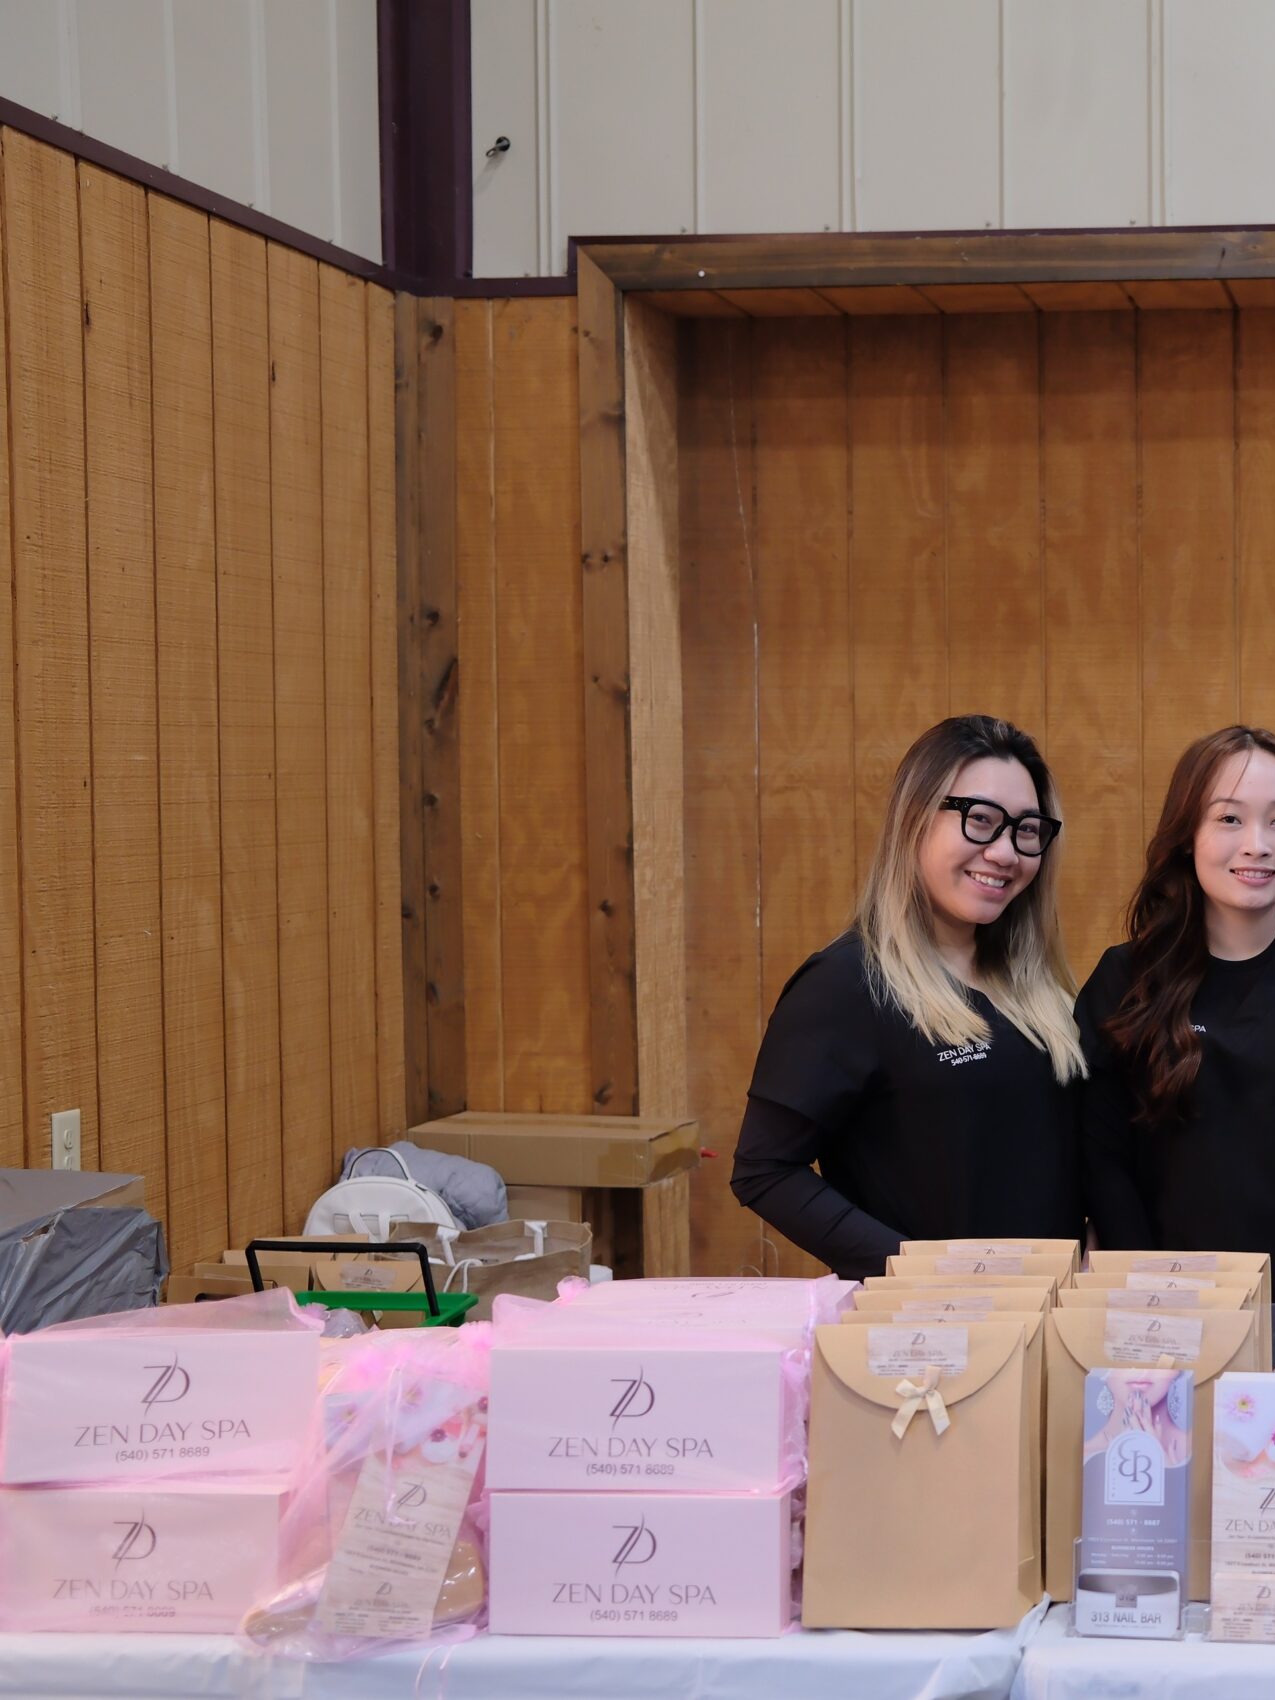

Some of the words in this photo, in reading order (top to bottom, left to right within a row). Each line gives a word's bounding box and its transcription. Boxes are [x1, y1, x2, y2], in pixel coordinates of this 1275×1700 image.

[937, 1049, 958, 1062] ZEN
[957, 1044, 974, 1056] DAY
[74, 1425, 129, 1447] ZEN
[139, 1421, 193, 1444] DAY
[201, 1418, 252, 1441] SPA
[115, 1449, 149, 1463] (540)
[153, 1448, 174, 1460] 571
[178, 1446, 210, 1458] 8689
[548, 1436, 599, 1458] ZEN
[608, 1437, 658, 1458] DAY
[665, 1437, 714, 1459] SPA
[586, 1463, 617, 1476] (540)
[620, 1463, 641, 1475] 571
[354, 1507, 385, 1525] ZEN
[424, 1521, 451, 1539] SPA
[1225, 1519, 1254, 1532] ZEN
[52, 1578, 102, 1600] ZEN
[110, 1579, 159, 1601] DAY
[167, 1580, 215, 1601] SPA
[552, 1582, 602, 1604] ZEN
[611, 1583, 661, 1604] DAY
[668, 1583, 717, 1606] SPA
[590, 1609, 622, 1623] (540)
[623, 1609, 645, 1621] 571
[648, 1610, 679, 1622] 8689
[1090, 1611, 1110, 1623] 313
[1113, 1611, 1137, 1624] NAIL
[1140, 1612, 1162, 1625] BAR
